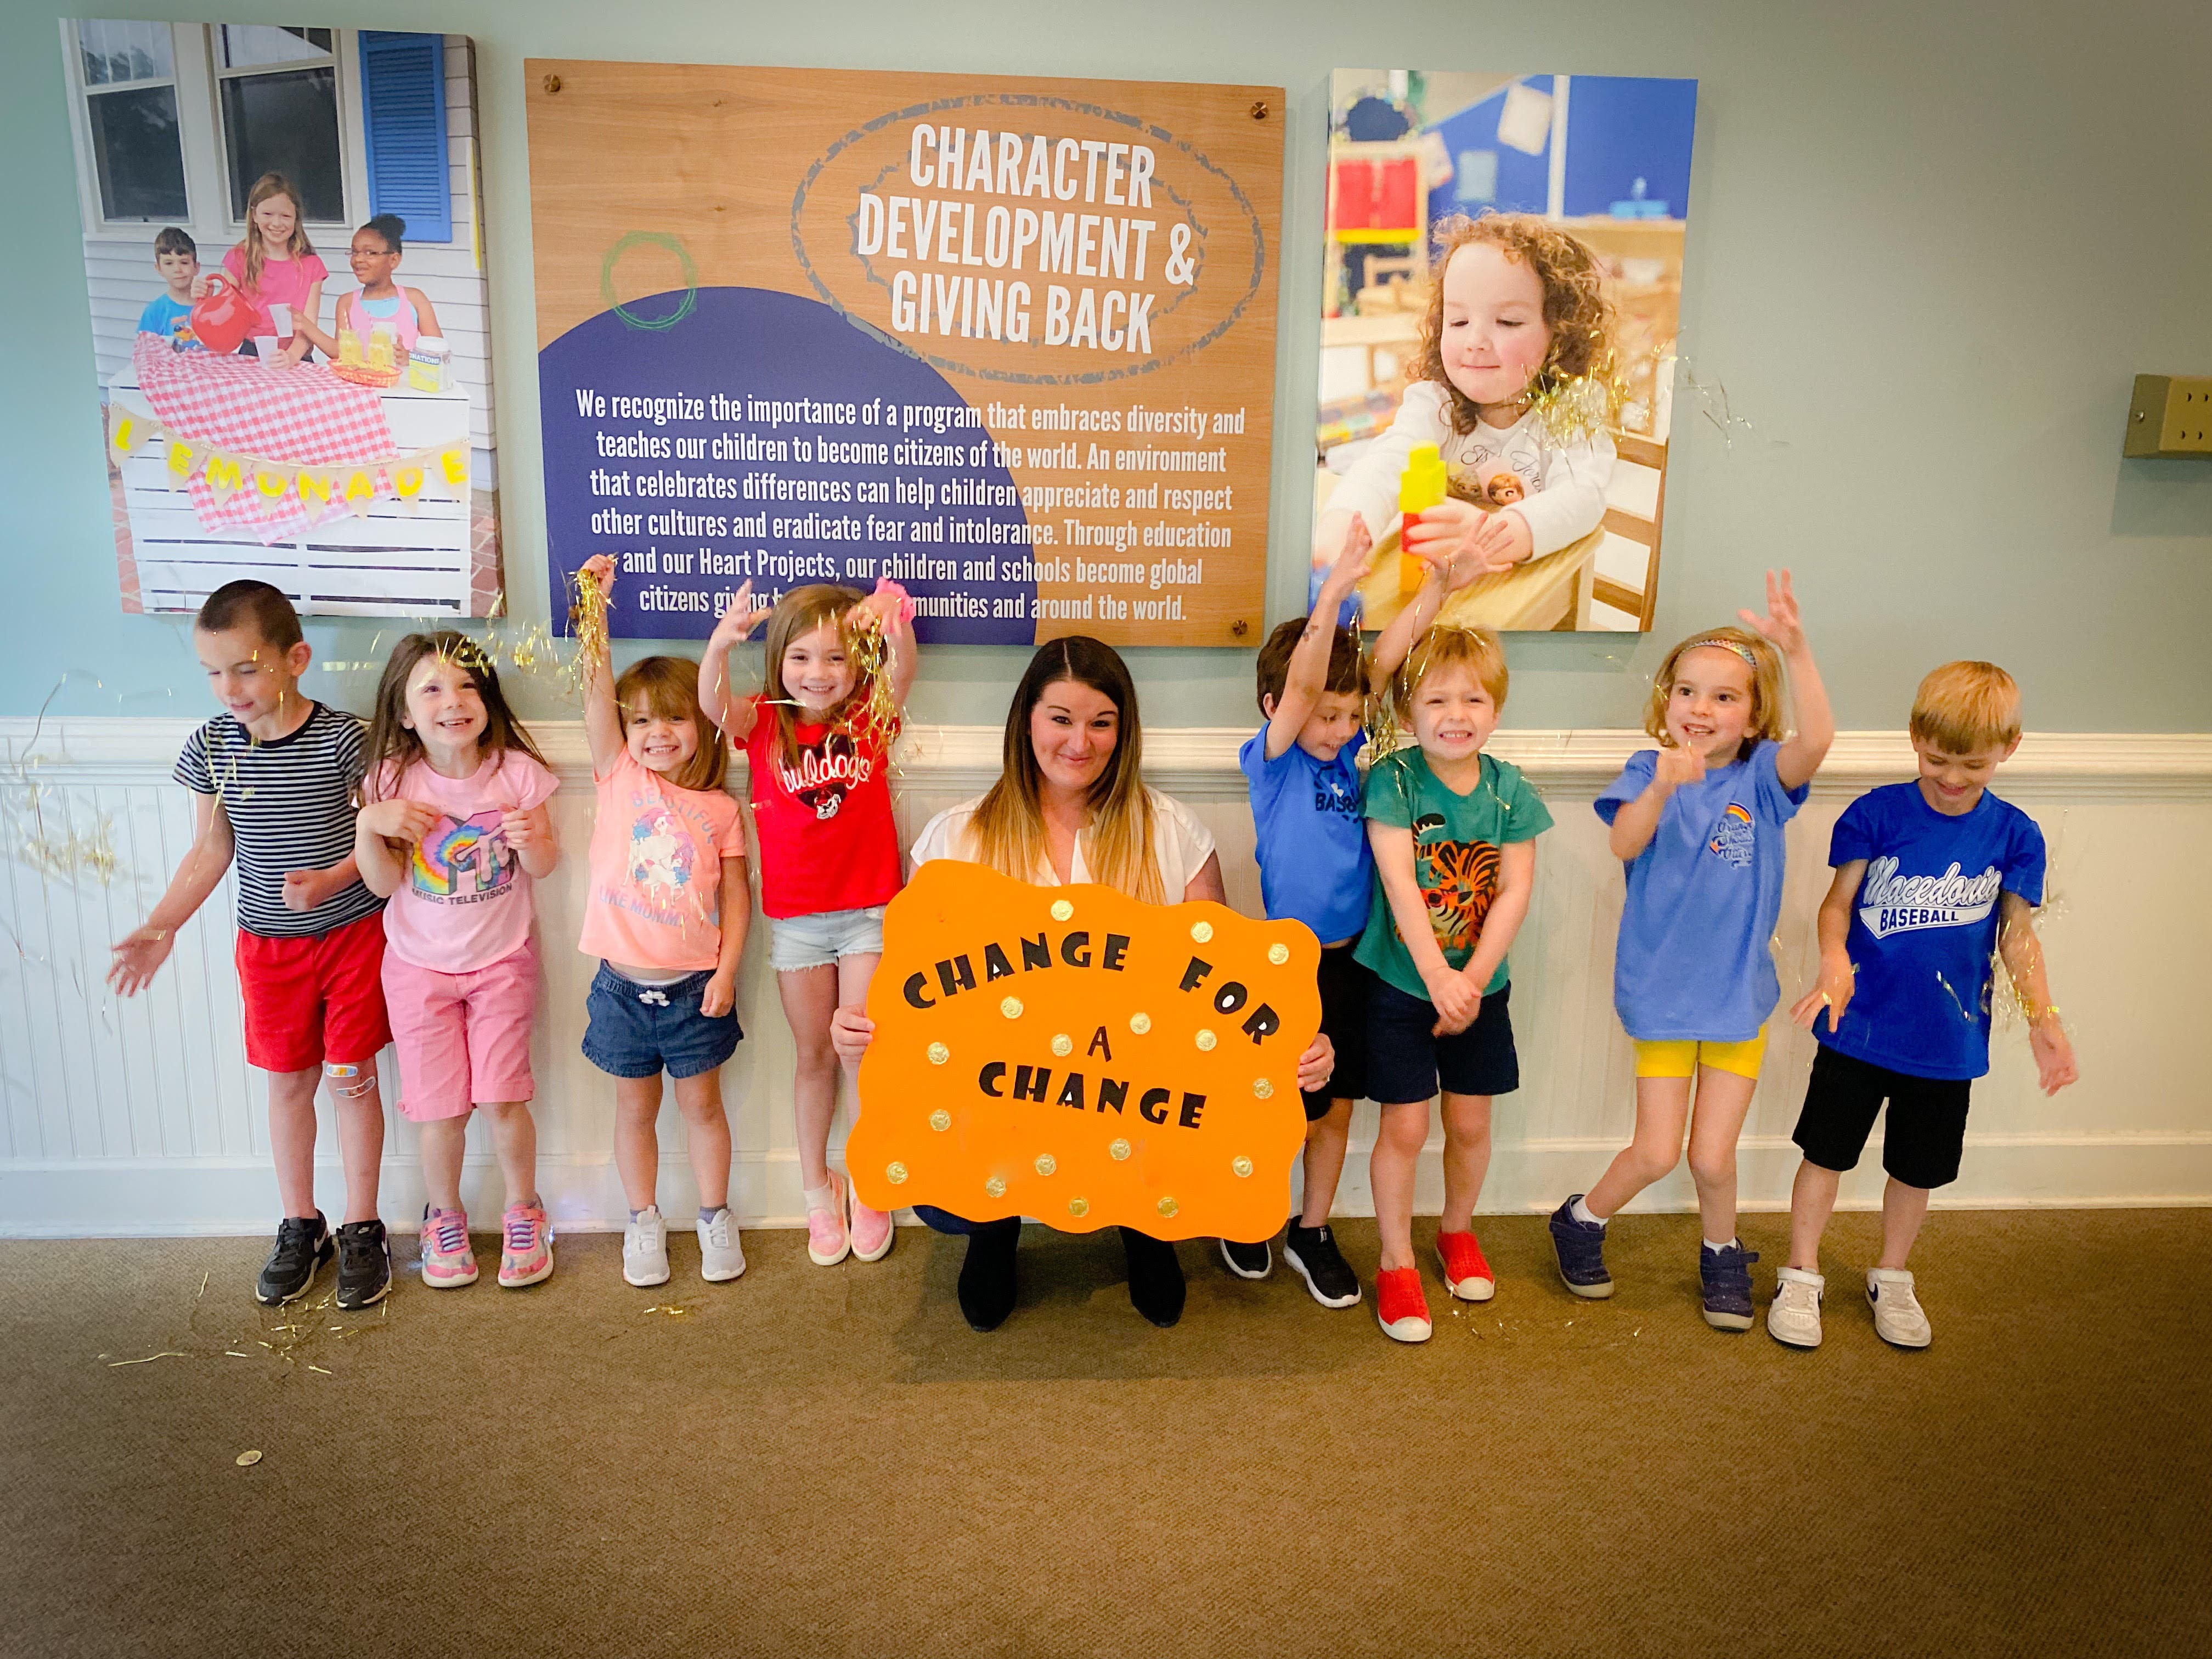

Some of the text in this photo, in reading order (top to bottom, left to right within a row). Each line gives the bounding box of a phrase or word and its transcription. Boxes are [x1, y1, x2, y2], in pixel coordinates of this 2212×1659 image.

[910, 123, 1155, 208] CHARACTER
[857, 193, 1195, 286] DEVELOPMENT &
[891, 270, 1155, 354] GIVING BACK
[575, 389, 1245, 440] We recognize the importance of a program that embraces diversity and
[114, 418, 467, 501] LEMONADE
[596, 430, 1226, 472] teaches our children to become citizens of the world. An environment
[590, 468, 1232, 516] that celebrates differences can help children appreciate and respect
[591, 507, 1231, 552] other cultures and eradicate fear and intolerance. Through education
[623, 546, 1201, 590] and our Heart Projects, our children and schools become global
[639, 585, 709, 612] citizens
[912, 591, 1186, 620] munities and around the world.
[631, 787, 718, 844] BEUTIFUL
[448, 882, 512, 905] TELEVISION
[1880, 908, 1959, 932] BASEBALL
[903, 931, 1279, 1045] CHANGE FOR
[1087, 1026, 1111, 1062] A
[978, 1062, 1206, 1129] CHANGE
